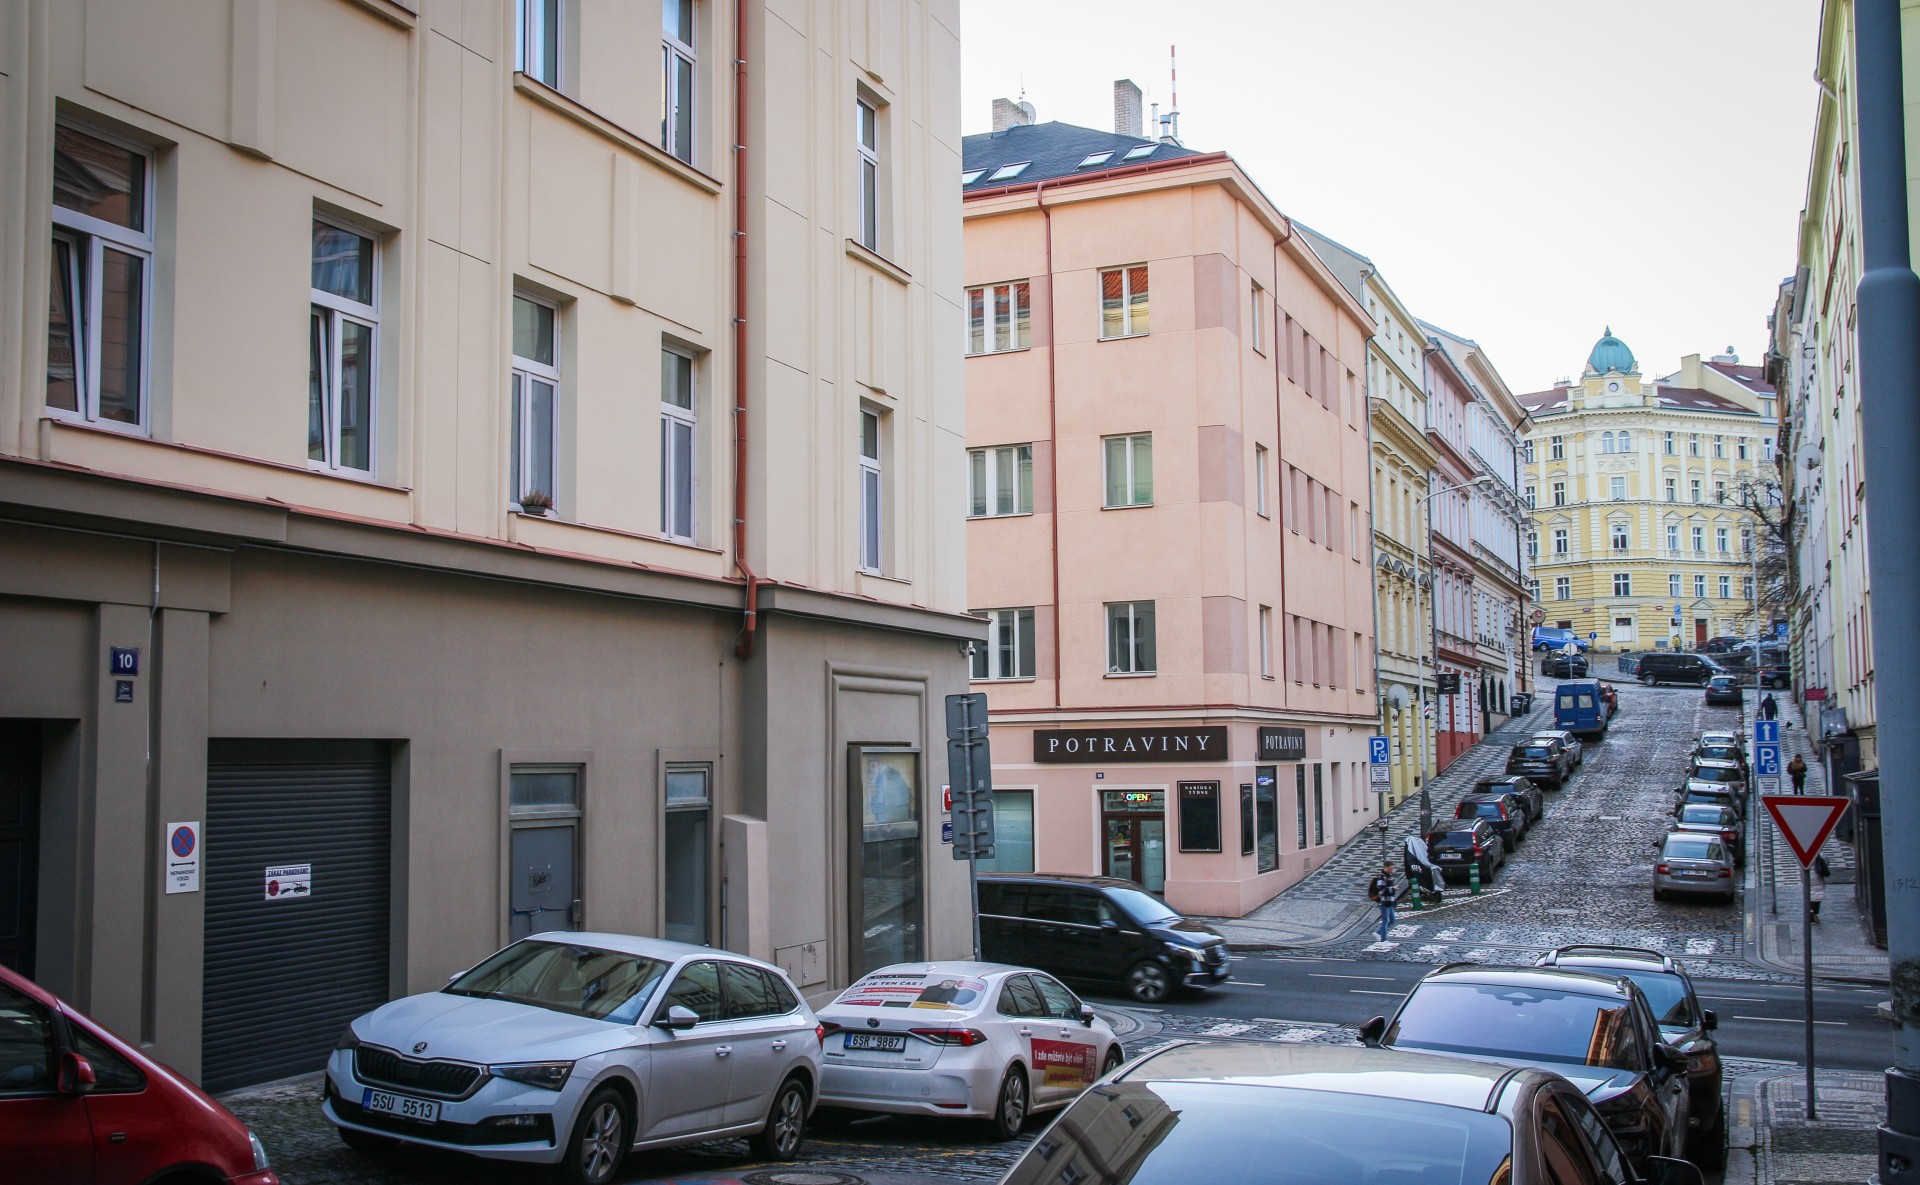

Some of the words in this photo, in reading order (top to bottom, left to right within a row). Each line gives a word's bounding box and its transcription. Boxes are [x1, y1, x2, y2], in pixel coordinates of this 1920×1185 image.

[119, 653, 133, 669] 10
[1048, 735, 1211, 753] POTRAVINY
[1265, 735, 1304, 750] POTRAVINY
[1373, 740, 1385, 757] P
[1761, 748, 1775, 767] P
[1126, 793, 1149, 801] OPEN
[852, 1035, 870, 1047] 6SR
[876, 1037, 900, 1048] 9887
[1038, 1050, 1047, 1061] zde
[1048, 1050, 1065, 1062] můžete
[1065, 1052, 1073, 1065] být
[372, 1093, 395, 1110] 5SU
[402, 1099, 433, 1118] 5513
